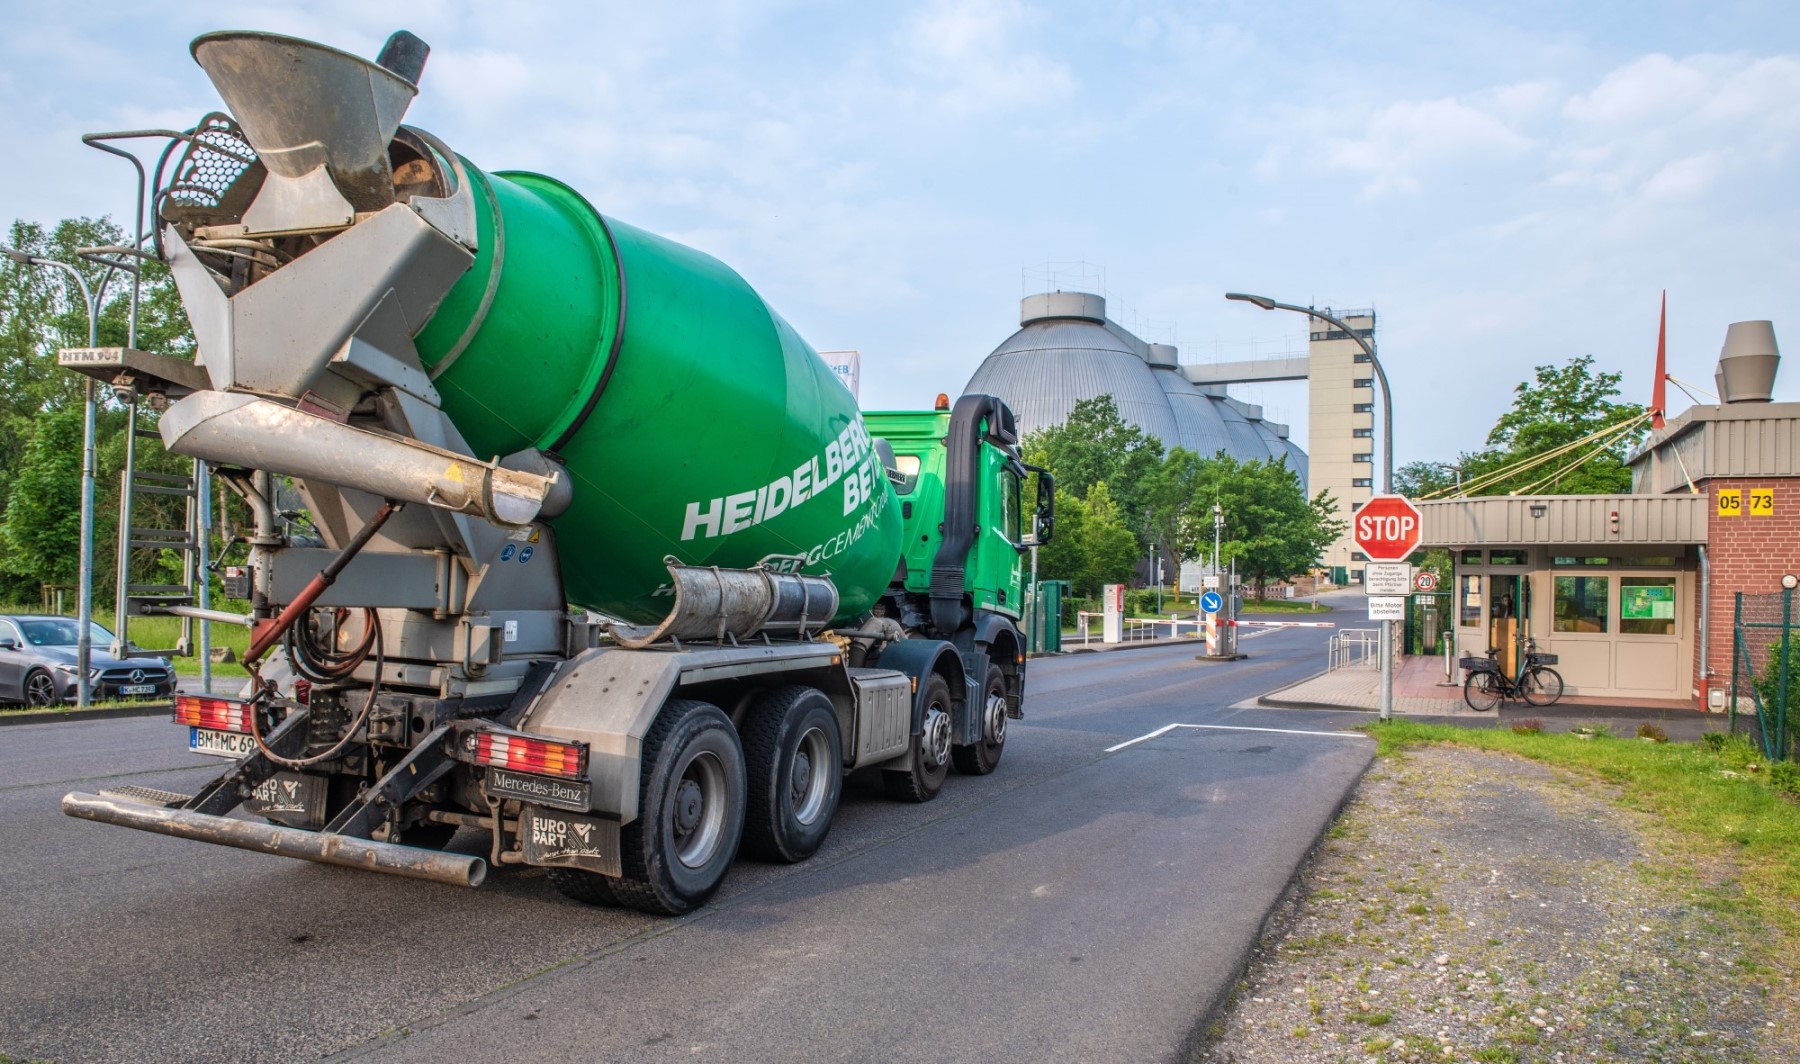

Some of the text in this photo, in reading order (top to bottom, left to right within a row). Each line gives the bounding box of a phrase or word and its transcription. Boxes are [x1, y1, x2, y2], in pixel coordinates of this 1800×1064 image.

[62, 351, 94, 361] HTM
[1720, 496, 1740, 509] 05
[1751, 495, 1772, 509] 73
[1359, 515, 1415, 541] STOP
[1420, 577, 1430, 586] 20
[197, 730, 214, 749] BM
[220, 734, 236, 752] MC
[494, 773, 581, 800] Mercedes-Benz
[533, 816, 567, 834] EURO
[533, 831, 567, 848] PART
